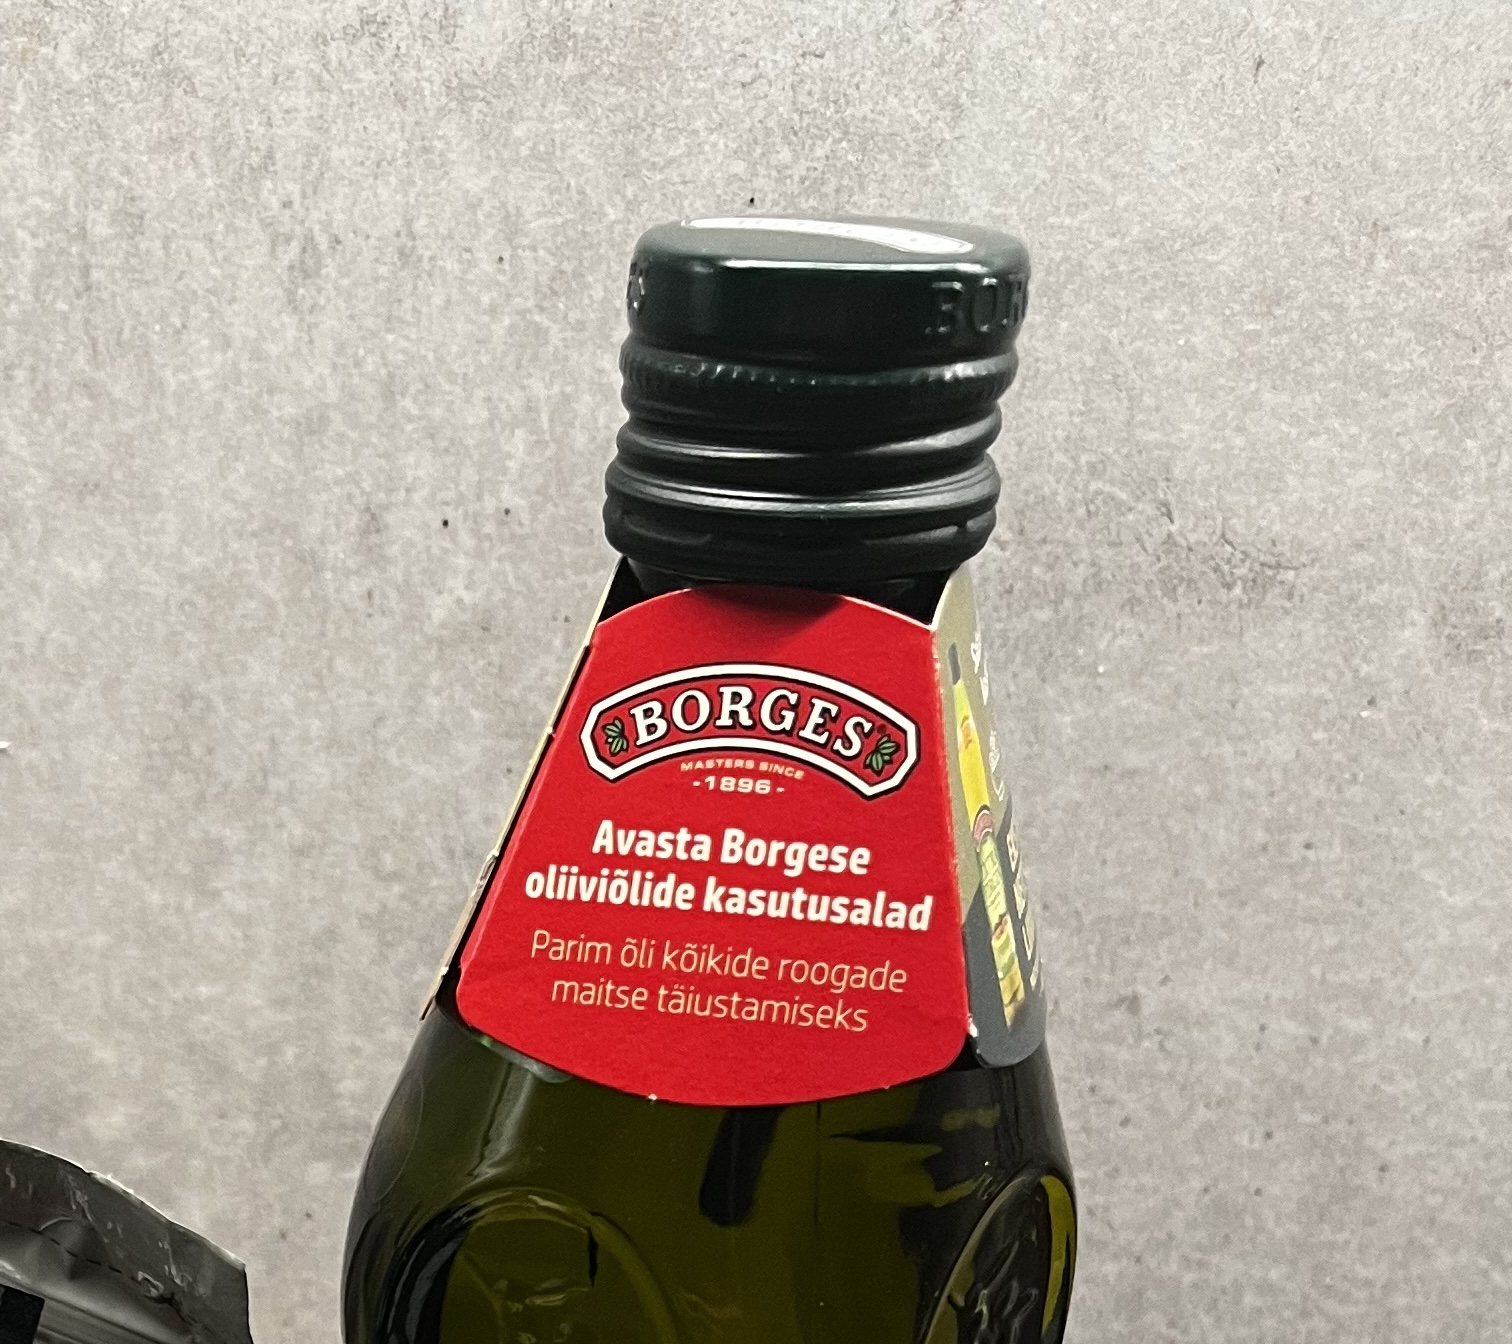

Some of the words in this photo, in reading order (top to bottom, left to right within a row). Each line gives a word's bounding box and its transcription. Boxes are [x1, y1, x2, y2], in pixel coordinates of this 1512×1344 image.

[629, 685, 874, 757] BORGES
[680, 759, 755, 773] MASTERS
[758, 761, 805, 780] SINCE
[592, 819, 712, 863] Avasta
[720, 828, 871, 880] Borgese
[524, 863, 695, 912] oliiviõlide
[702, 873, 934, 932] kasutusalad
[530, 928, 610, 966] Parim
[619, 935, 655, 971] õli
[662, 938, 770, 983] kõikide
[777, 955, 908, 996] roogade
[550, 978, 649, 1012] maitse
[656, 984, 870, 1034] täiustamiseks
